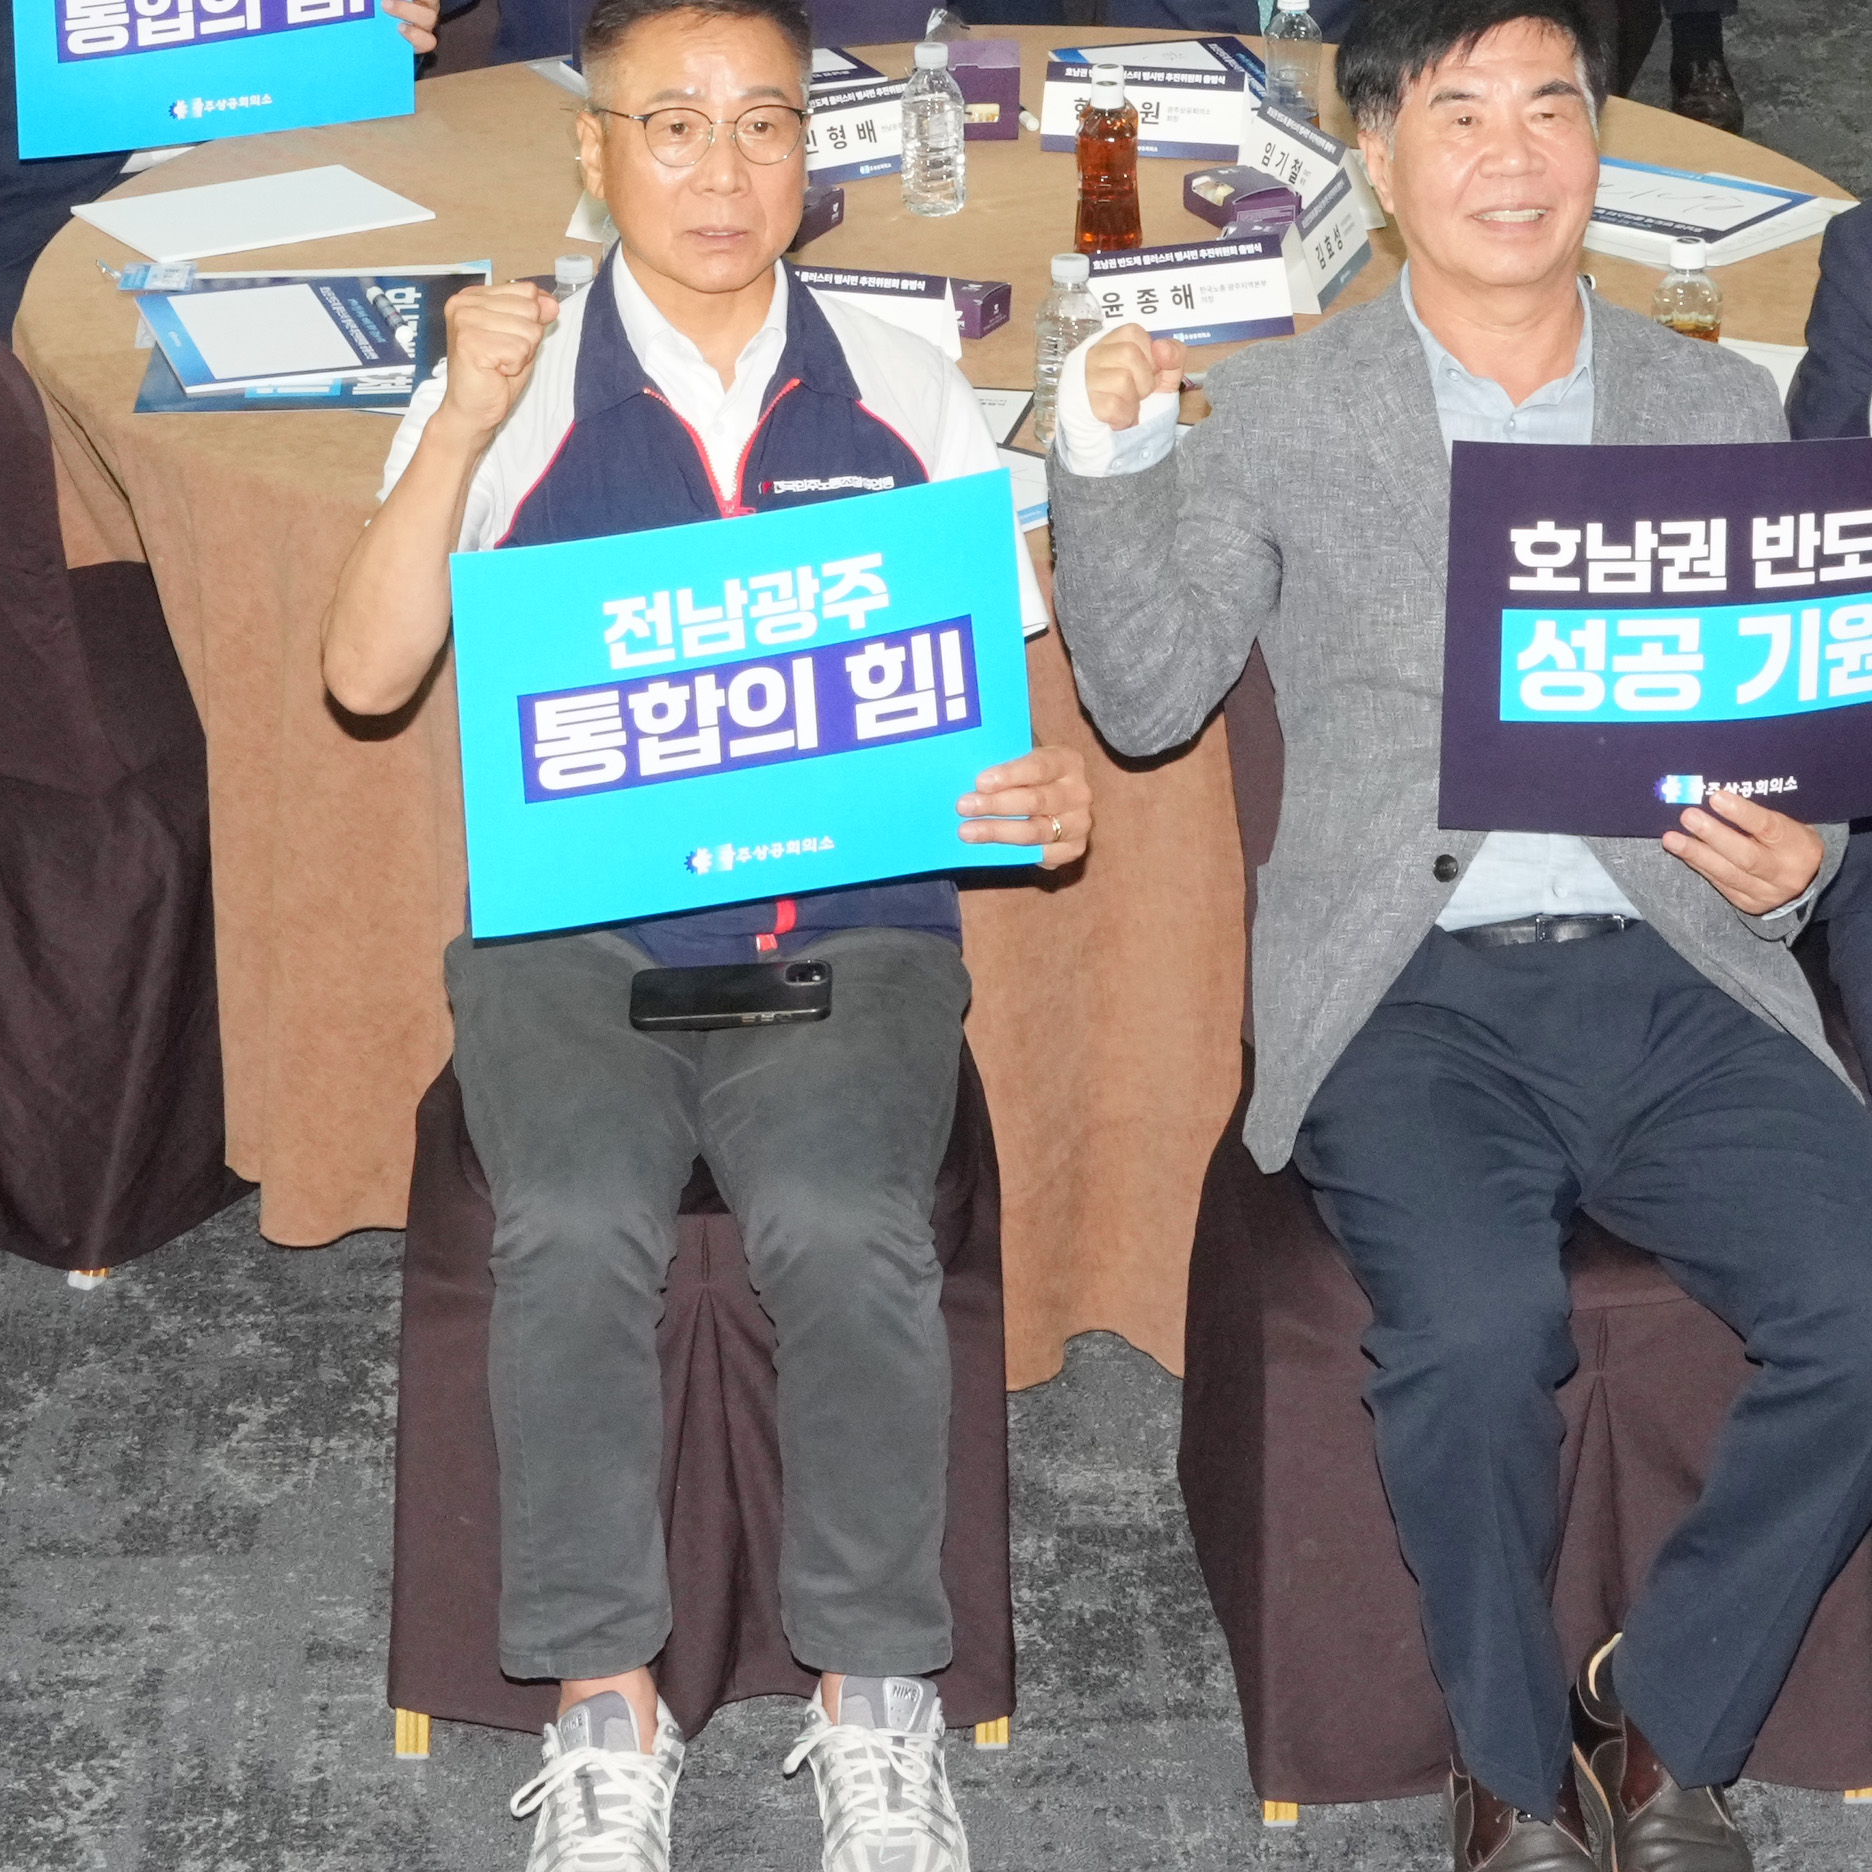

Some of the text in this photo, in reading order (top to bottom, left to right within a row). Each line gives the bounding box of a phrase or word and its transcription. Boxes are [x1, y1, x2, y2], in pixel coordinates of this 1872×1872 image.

[1509, 518, 1727, 594] 호남권
[603, 552, 887, 670] 전남광주
[534, 629, 967, 791] 통합의 힘!
[1517, 617, 1705, 712] 성공
